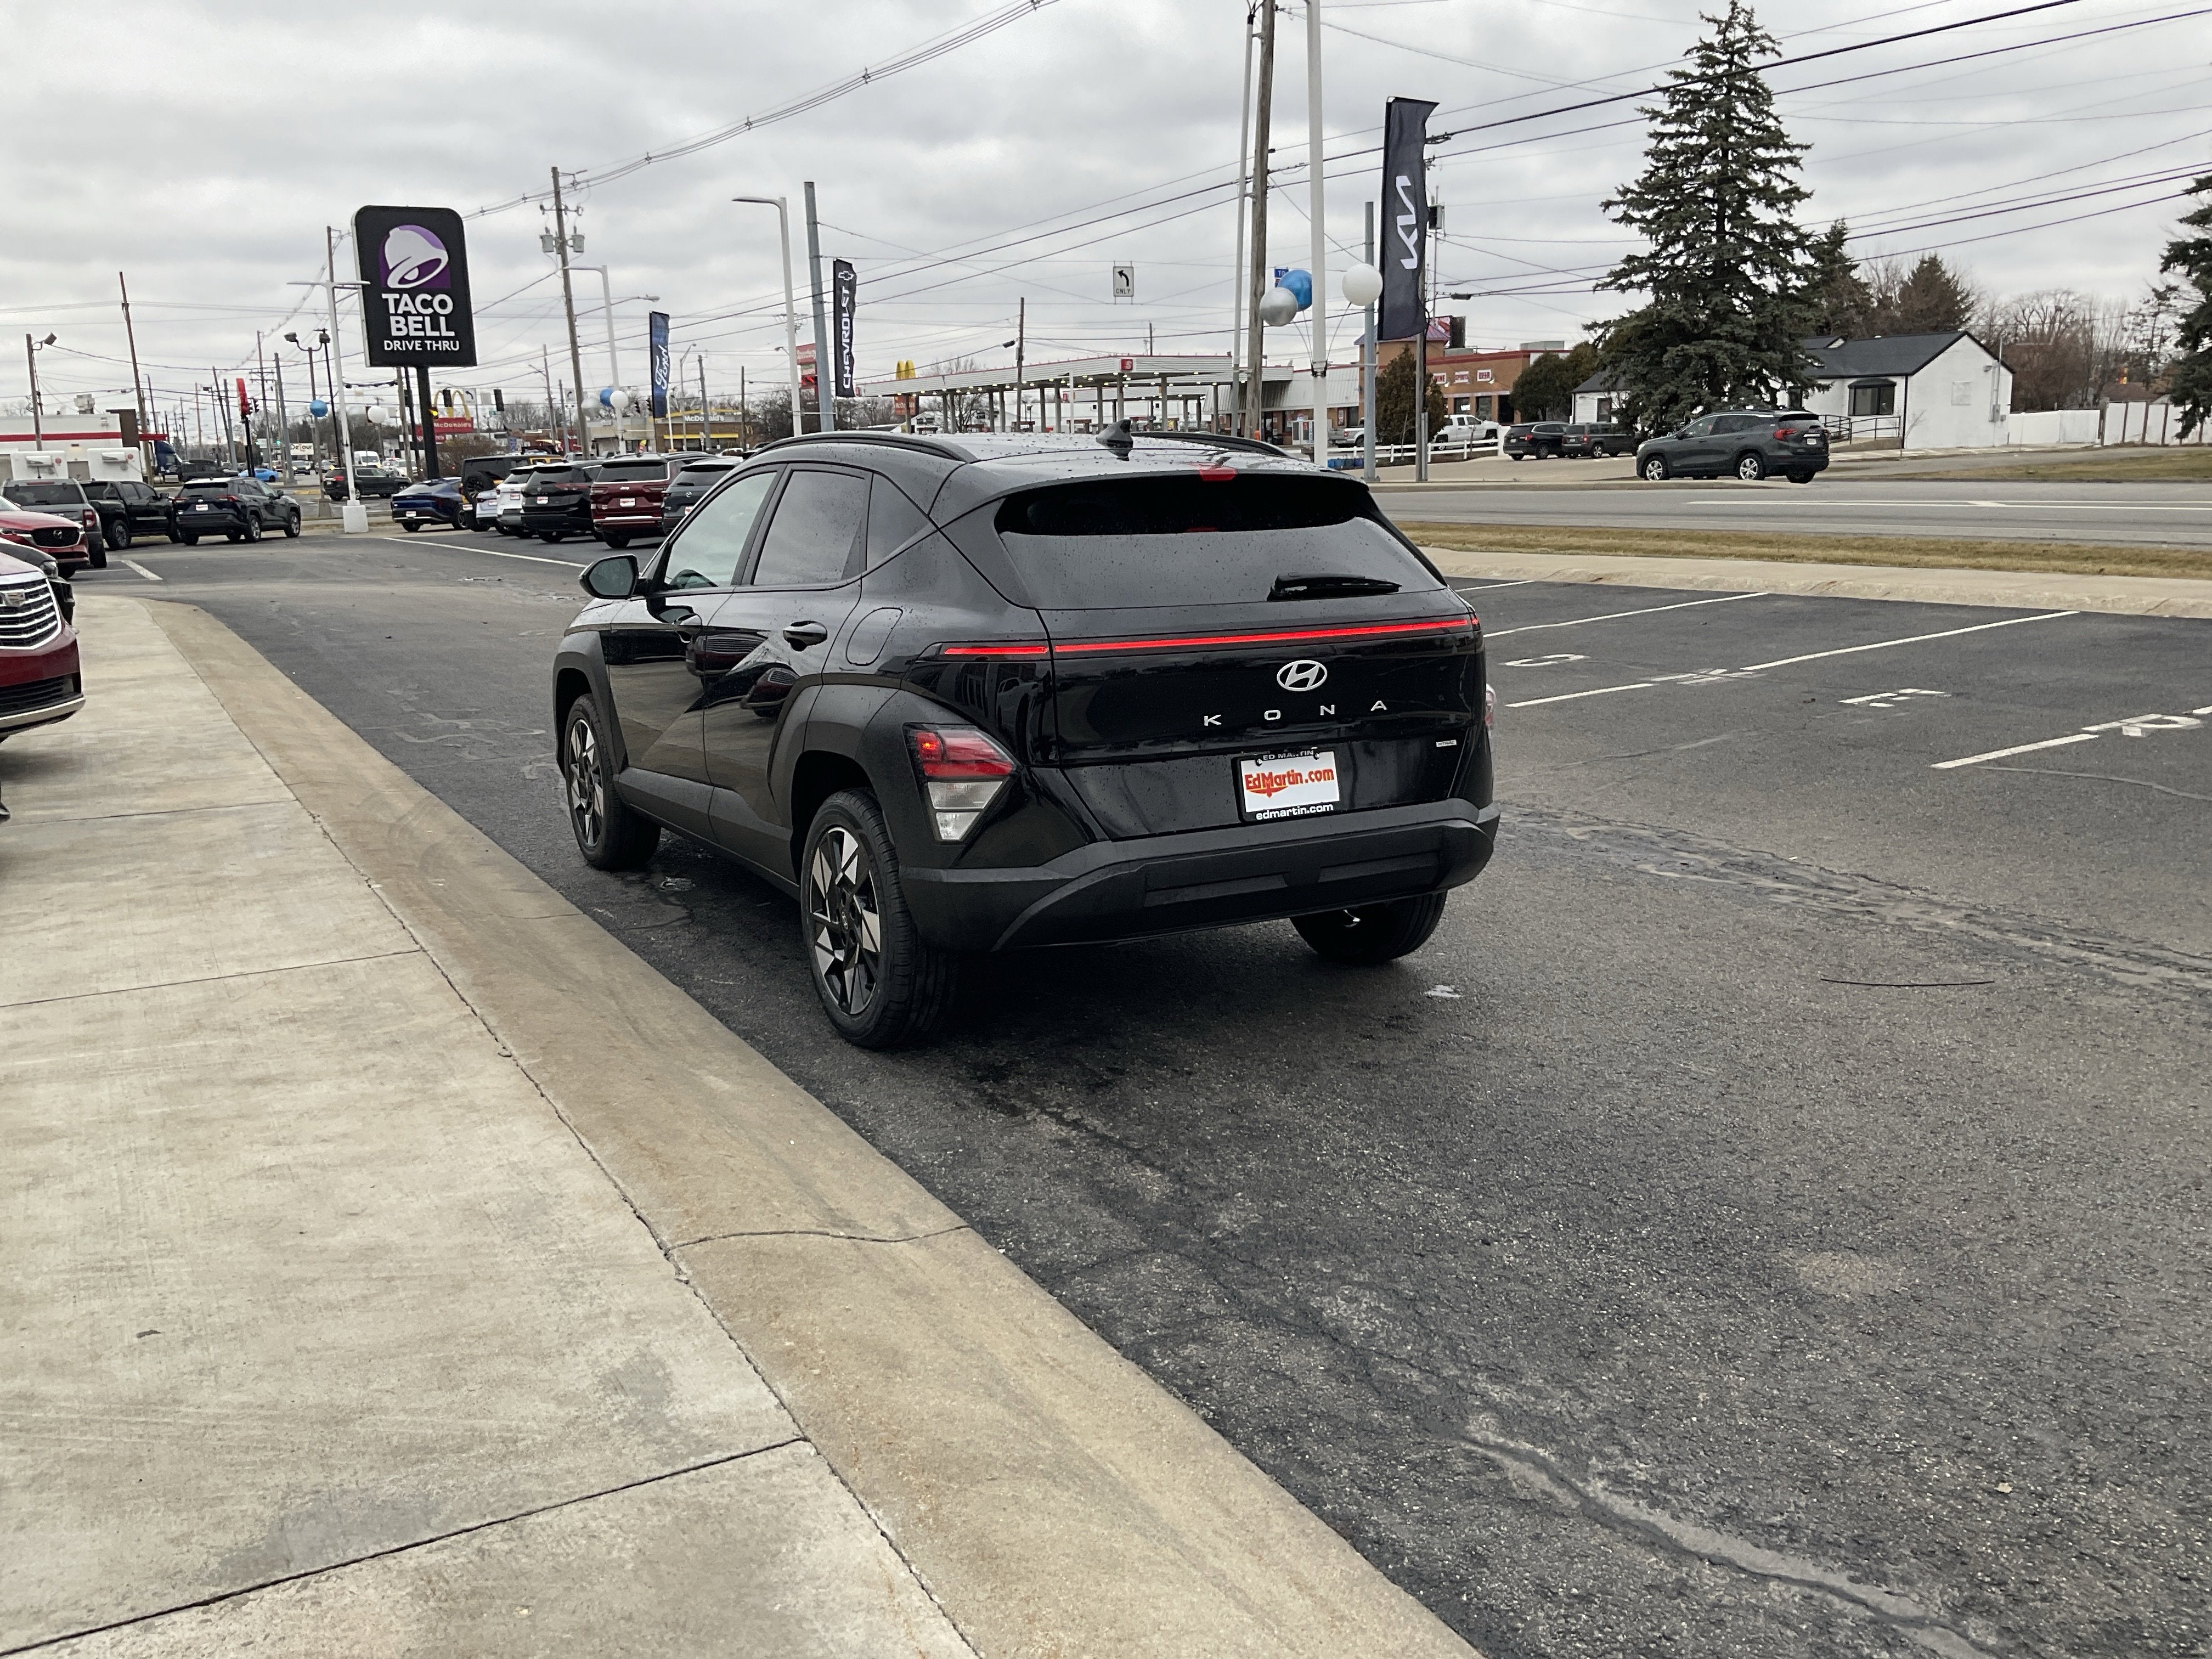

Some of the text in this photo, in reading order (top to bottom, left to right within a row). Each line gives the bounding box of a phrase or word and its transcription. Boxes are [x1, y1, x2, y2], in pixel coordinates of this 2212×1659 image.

[381, 293, 453, 314] TACO
[390, 315, 455, 336] BELL
[841, 285, 851, 389] CHEVROLET
[384, 340, 460, 351] DRIVE THRU
[655, 344, 669, 390] Ford
[1204, 700, 1387, 726] KONA
[1244, 768, 1335, 794] EdMartin.com
[1255, 803, 1334, 821] edmartin.com
